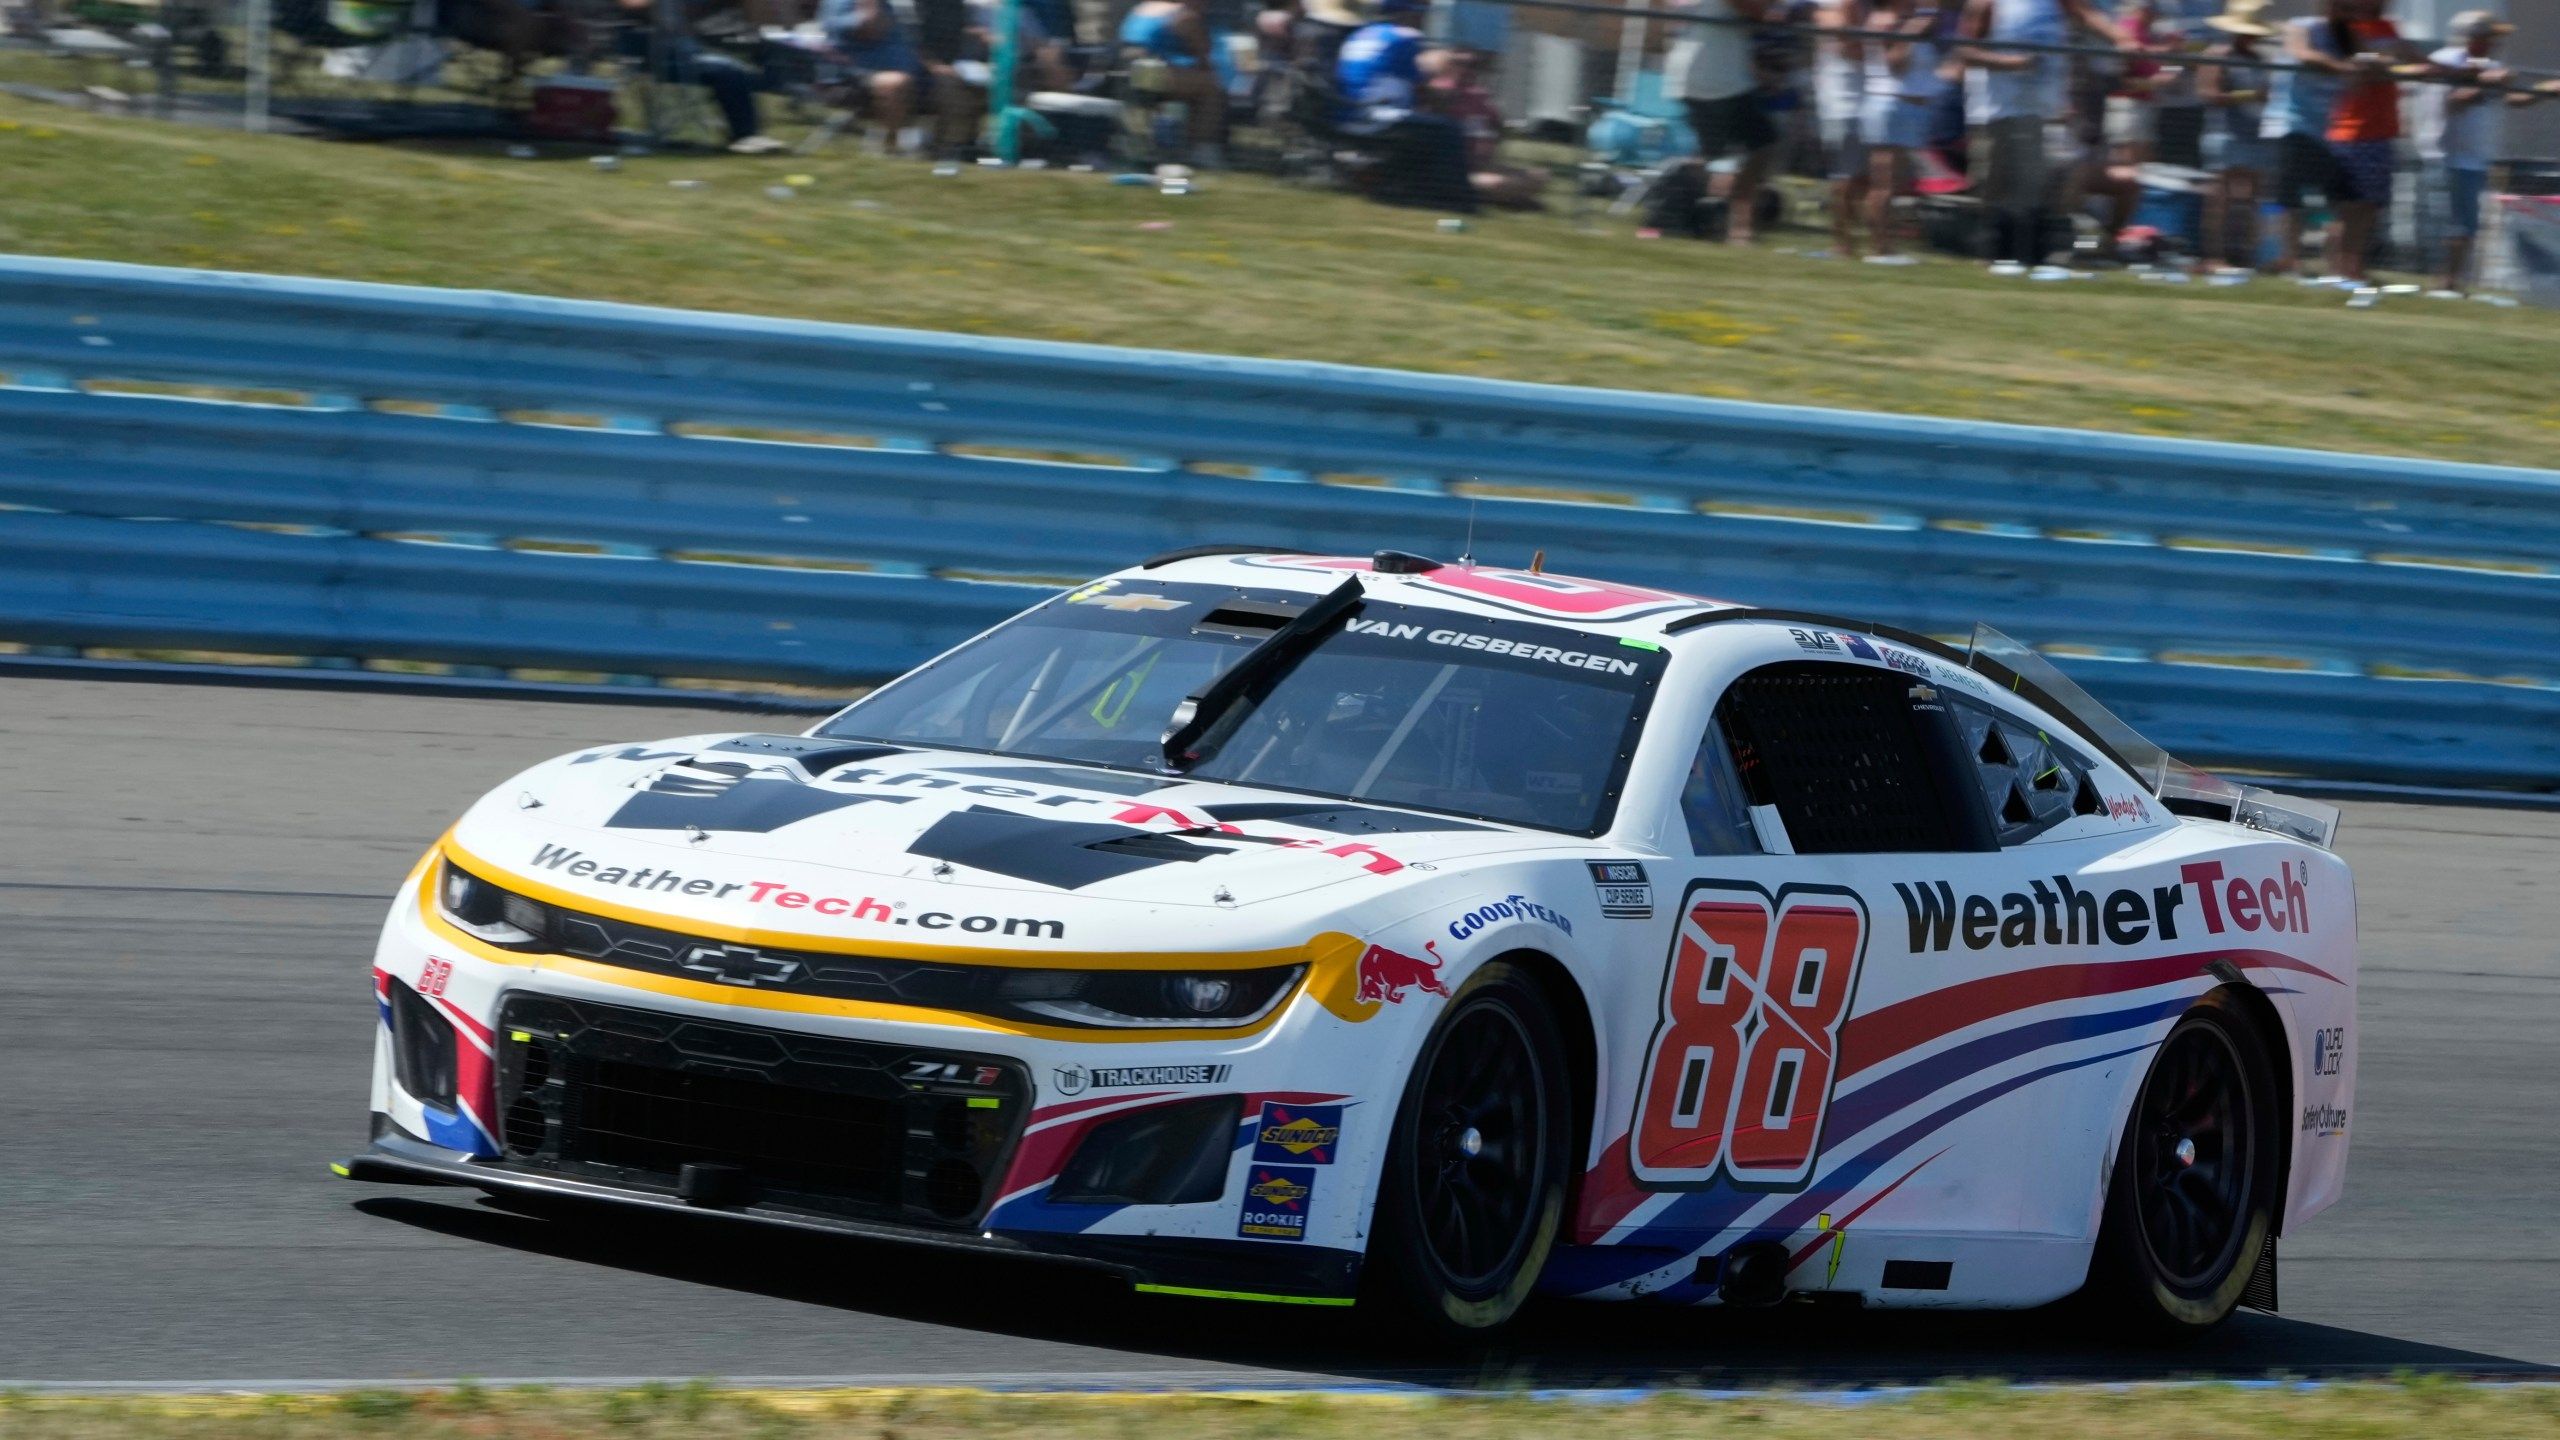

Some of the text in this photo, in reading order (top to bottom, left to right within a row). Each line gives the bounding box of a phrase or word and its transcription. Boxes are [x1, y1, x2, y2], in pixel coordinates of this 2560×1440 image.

[1345, 617, 1639, 676] VAN GISBERGEN
[1789, 629, 1841, 650] SVG
[1935, 664, 1990, 695] SIEMENS
[1606, 866, 1640, 880] NASCAR
[1606, 889, 1644, 904] CUP SERIES
[1449, 896, 1573, 940] GOODYEAR
[417, 956, 454, 998] 88
[1630, 882, 1868, 1187] 88
[2325, 1027, 2344, 1050] QUAD
[901, 1061, 1001, 1086] ZL1
[2323, 1052, 2343, 1075] LOCK
[1098, 1066, 1211, 1087] TRACKHOUSE
[2302, 1104, 2346, 1134] SafetyCulture
[1265, 1127, 1338, 1143] SUNOCO
[1244, 1212, 1304, 1227] ROOKIE
